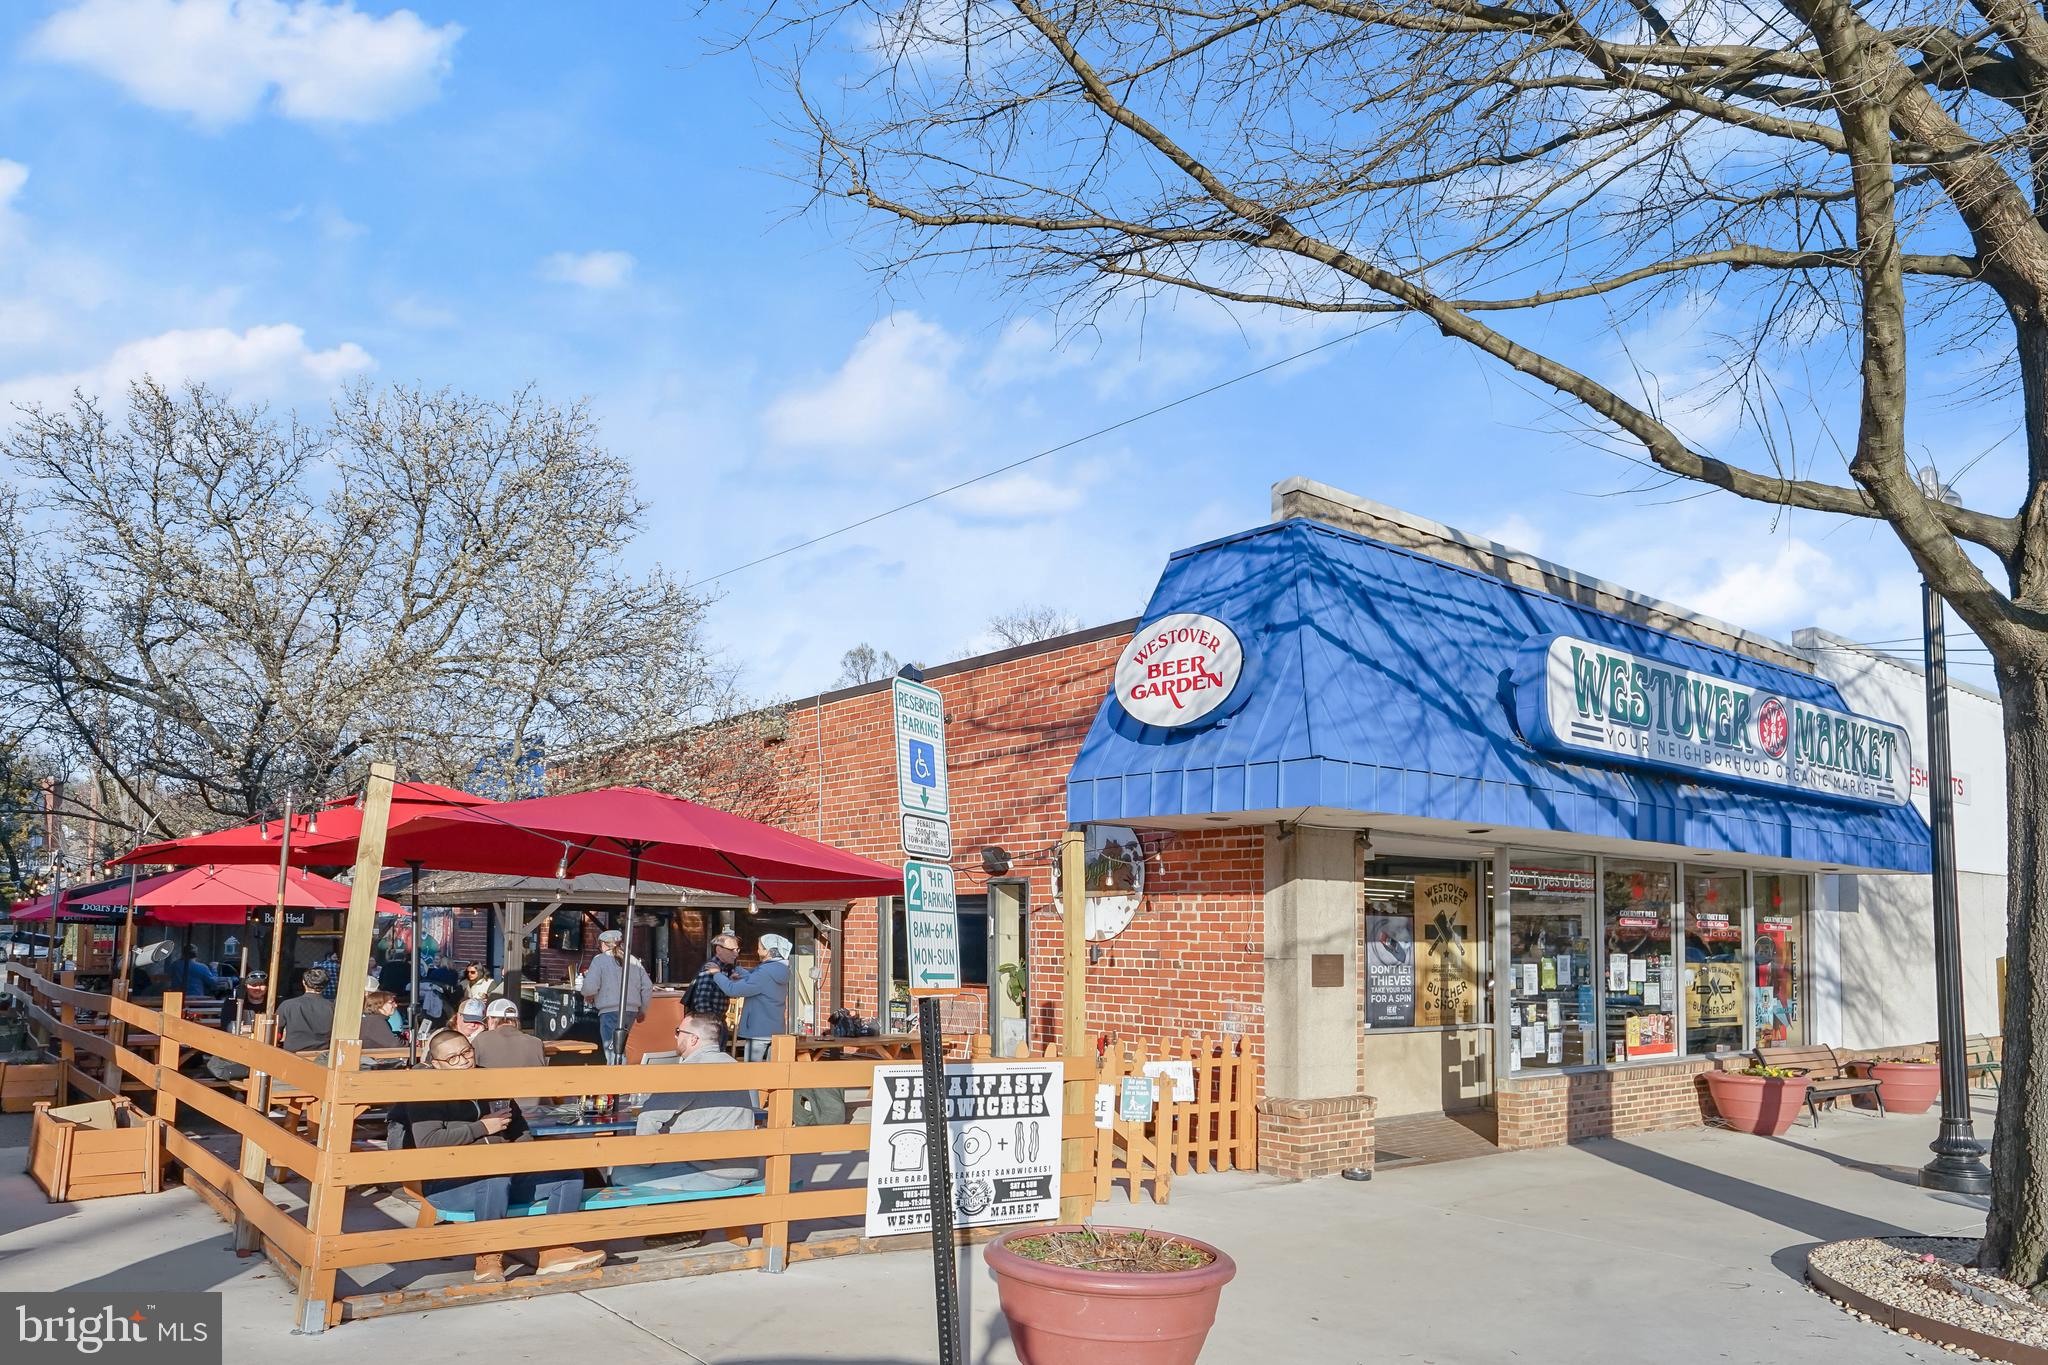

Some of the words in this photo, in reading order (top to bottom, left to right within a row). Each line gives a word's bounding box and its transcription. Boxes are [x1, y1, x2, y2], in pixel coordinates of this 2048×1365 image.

[1133, 628, 1221, 665] WESTOVER
[1147, 655, 1209, 679] BEER
[1130, 672, 1223, 709] GARDEN
[898, 691, 940, 718] RESERVED
[1570, 645, 1754, 754] WESTOVER
[1795, 707, 1897, 783] MARKET
[902, 714, 939, 739] PARKING
[1605, 728, 1650, 752] YOUR
[1658, 740, 1770, 775] NEIGHBORHOOD
[1776, 764, 1828, 787] ORGANIC
[1834, 776, 1876, 798] MARKET
[917, 820, 936, 829] PENALTY
[908, 835, 934, 846] TOW-AWAY
[935, 840, 947, 848] ZONE
[908, 869, 921, 905] 2
[930, 872, 943, 888] HR
[1532, 871, 1560, 889] Types
[1563, 873, 1572, 887] of
[1573, 874, 1595, 889] Beer
[923, 891, 952, 909] PARKING
[1424, 882, 1469, 901] WESTOVER
[1430, 893, 1464, 908] MARKET
[285, 913, 305, 923] Head
[913, 921, 953, 939] 8AM-6PM
[914, 948, 954, 965] MON-SUN
[1371, 965, 1397, 974] DON'T
[1398, 965, 1412, 974] LET
[1370, 975, 1412, 986] THIEVES
[1371, 986, 1386, 994] TAKE
[1386, 986, 1400, 994] YOUR
[1371, 994, 1387, 1003] FOR
[1388, 995, 1395, 1003] A
[1395, 994, 1412, 1003] SPIN
[1426, 981, 1468, 999] BUTCHER
[1433, 997, 1460, 1010] SHOP
[1692, 1000, 1720, 1015] BUTCHER
[1721, 1000, 1736, 1013] SHOP
[894, 1074, 1044, 1098] BRAKFAST
[891, 1095, 1044, 1121] SADWICHES
[878, 1176, 900, 1185] BEER
[904, 1174, 933, 1183] GARD
[948, 1169, 991, 1179] REAKFAST
[995, 1165, 1051, 1176] SANDWICHES!
[1010, 1182, 1020, 1190] SAT
[959, 1196, 988, 1206] BRUNCH
[888, 1211, 957, 1226] WESTOR
[990, 1203, 1040, 1217] MARKET
